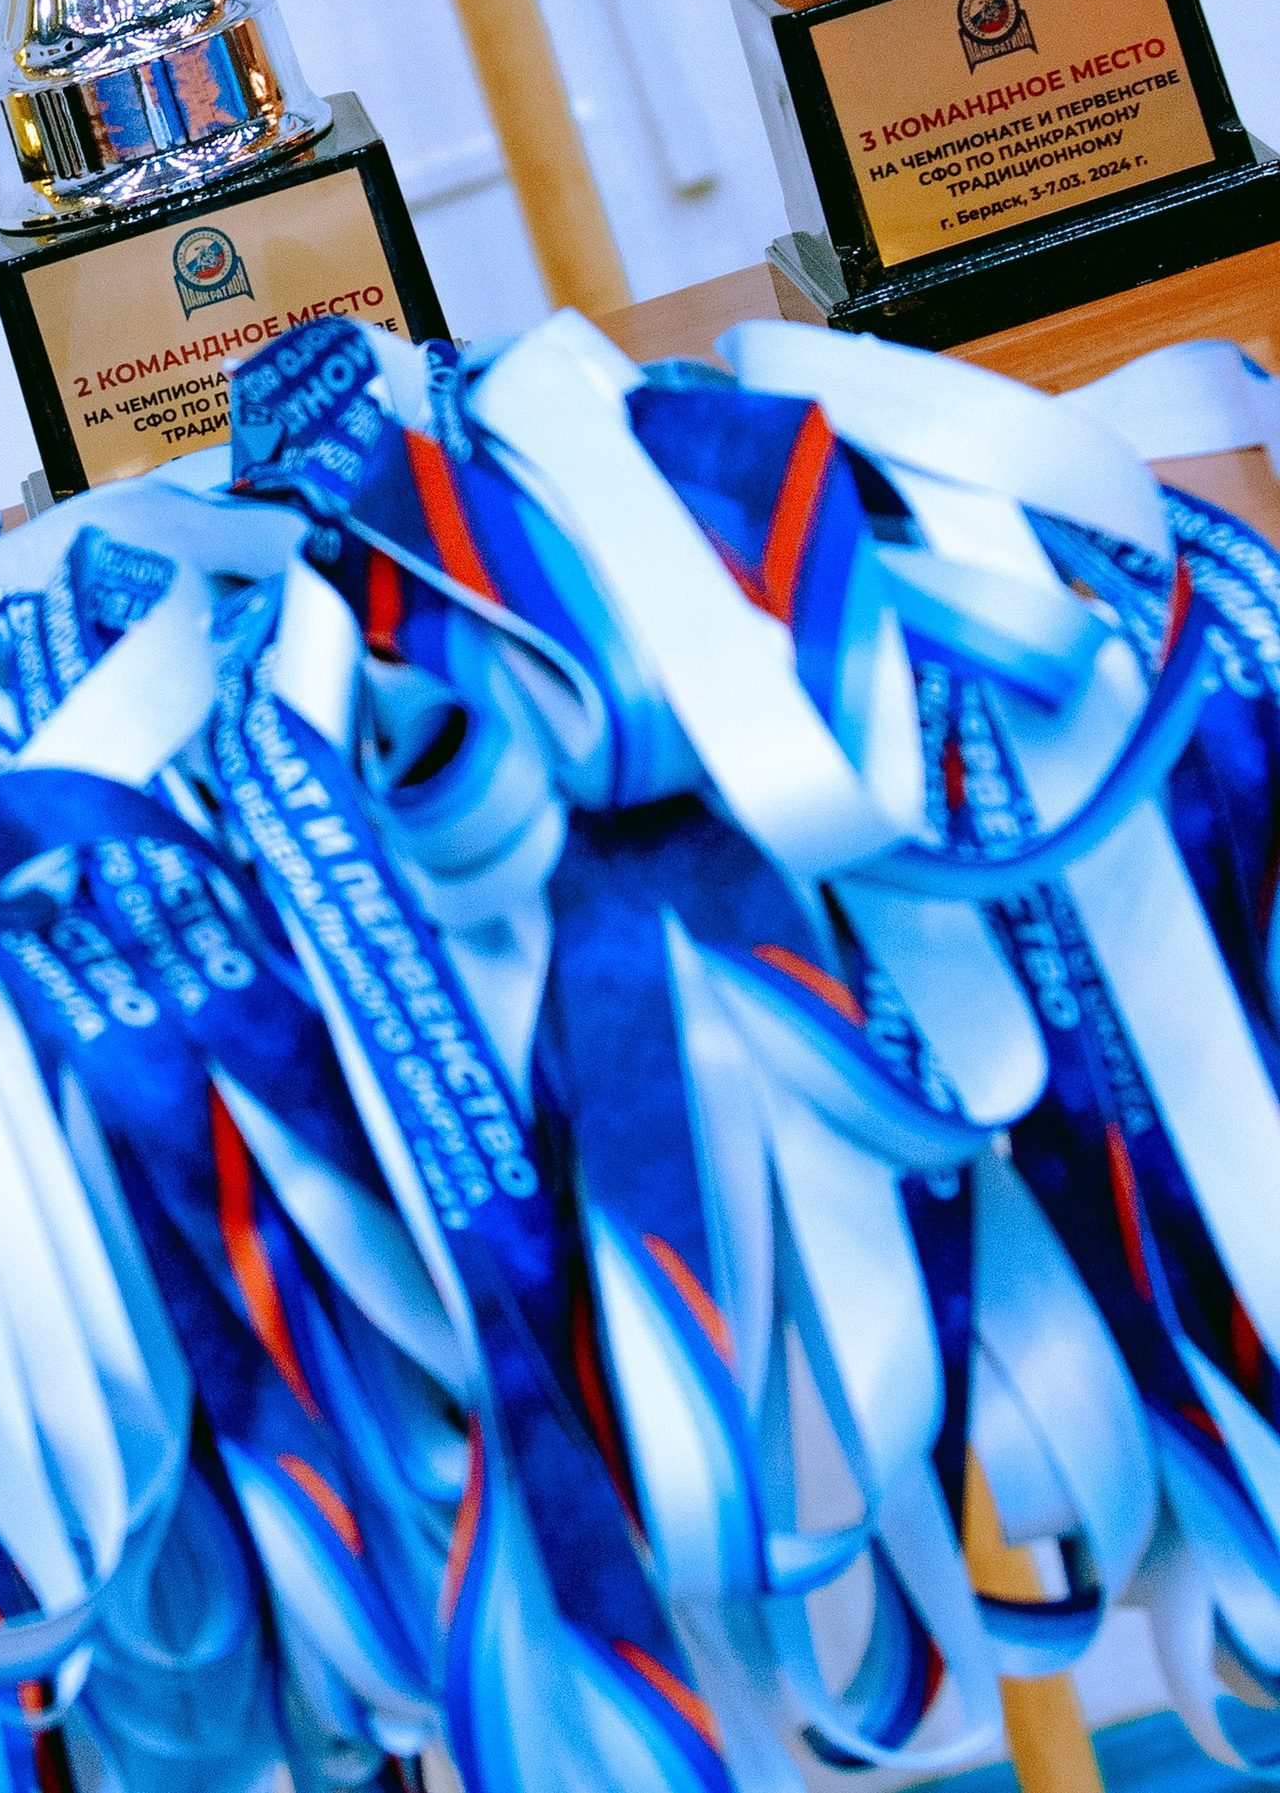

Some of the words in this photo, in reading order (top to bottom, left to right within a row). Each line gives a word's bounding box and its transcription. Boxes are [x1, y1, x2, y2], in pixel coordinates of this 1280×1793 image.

[860, 131, 876, 151] 3
[882, 70, 1065, 145] КОМАНДНОЕ
[1070, 39, 1165, 83] МЕСТО
[870, 162, 899, 181] НА
[901, 116, 1034, 169] ЧЕМПИОНАТЕ
[1038, 111, 1053, 126] И
[1056, 70, 1180, 120] ПЕРВЕНСТВЕ
[919, 163, 961, 185] СФО
[966, 152, 994, 171] ПО
[999, 103, 1140, 160] ПАНКРАТИОНУ
[946, 129, 1123, 197] ТРАДИЦИОННОМУ
[941, 219, 954, 230] г.
[956, 195, 1028, 225] Бердск,
[1088, 158, 1131, 182] 2024
[1135, 155, 1148, 167] г.
[74, 377, 92, 397] 2
[97, 316, 283, 390] КОМАНДНОЕ
[287, 286, 383, 327] МЕСТО
[84, 408, 113, 427] НА
[116, 372, 228, 414] ЧЕМПИОНА
[134, 409, 177, 431] СФО
[182, 398, 210, 417] ПО
[327, 859, 540, 1201] ПЕРВЕНСТВО
